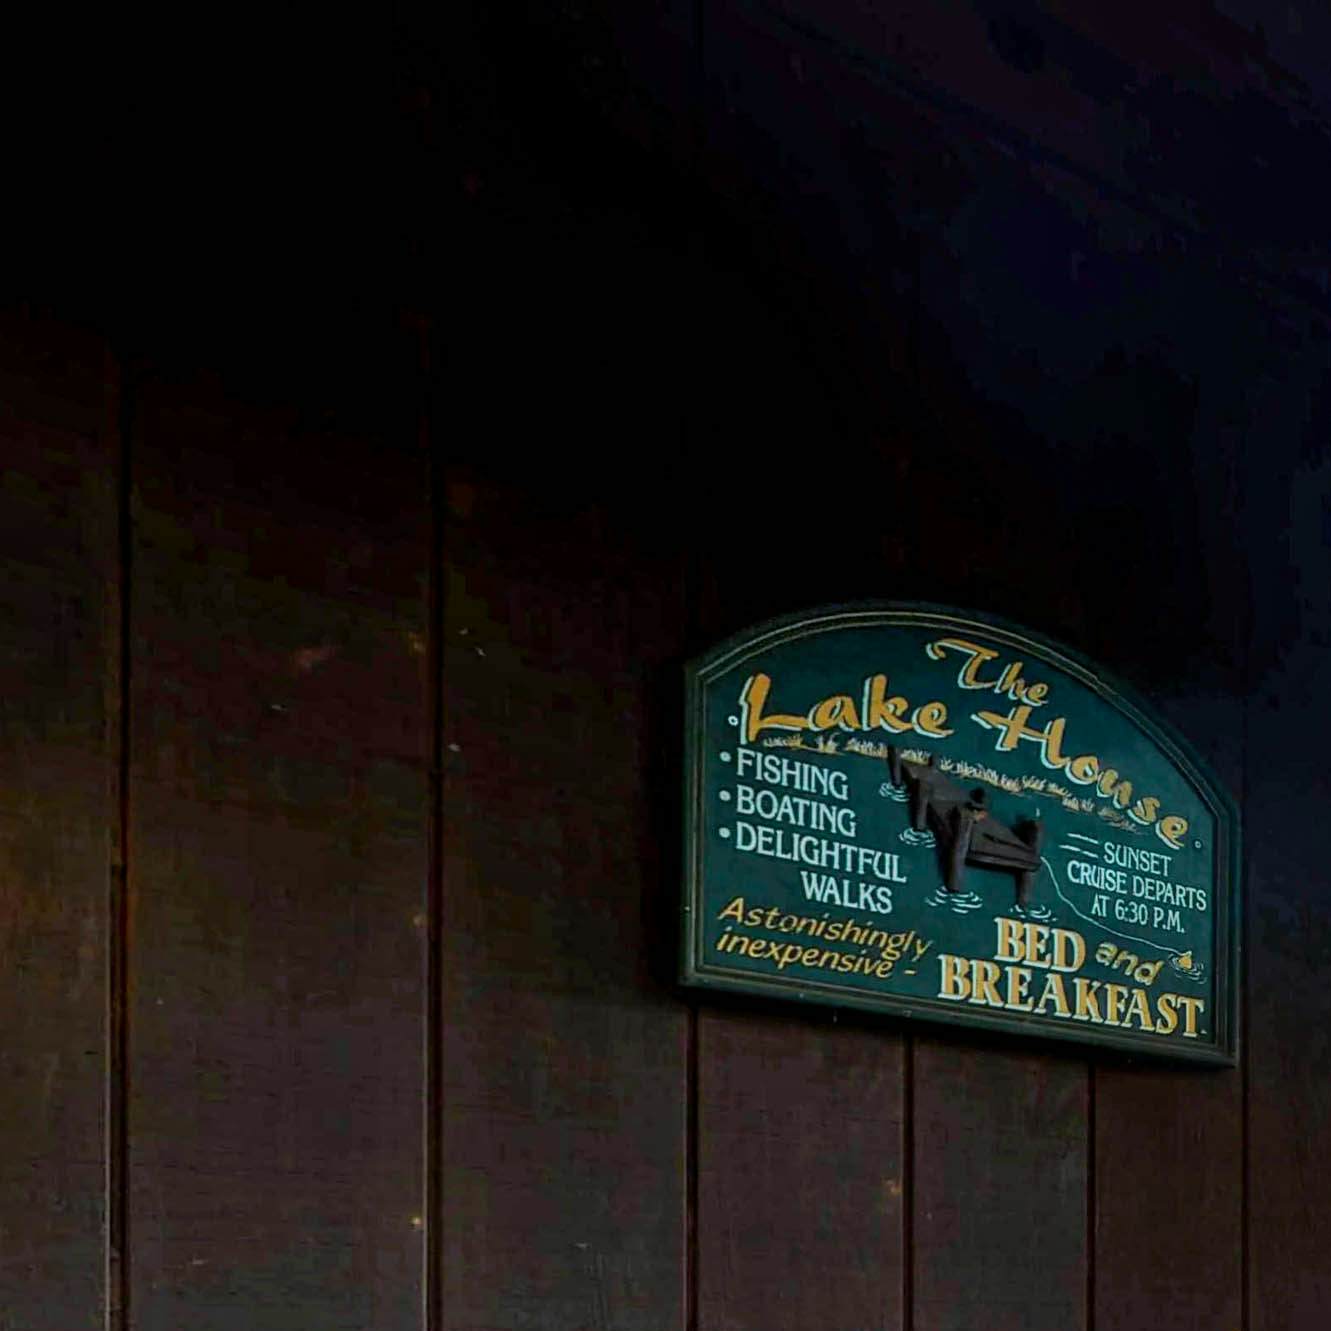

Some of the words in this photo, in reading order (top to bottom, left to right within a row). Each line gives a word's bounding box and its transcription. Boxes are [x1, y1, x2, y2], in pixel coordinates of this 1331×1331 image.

[926, 638, 1048, 706] The
[736, 747, 849, 800] FISHING
[738, 673, 955, 745] Lake
[970, 705, 1188, 850] House
[736, 784, 857, 837] BOATING
[736, 821, 907, 883] DELIGHTFUL
[1103, 841, 1173, 877] SUNSET
[800, 871, 893, 914] WALKS
[1067, 859, 1128, 895] CRUISE
[1132, 875, 1208, 912] DEPARTS
[718, 897, 934, 962] Astonishingly
[1091, 894, 1110, 917] AT
[1115, 899, 1149, 926] 6:30
[1153, 907, 1186, 934] P.M.
[716, 926, 893, 979] inexpensive
[994, 916, 1087, 973] BED
[1095, 941, 1164, 986] and
[937, 953, 1205, 1037] BREAKFAST
